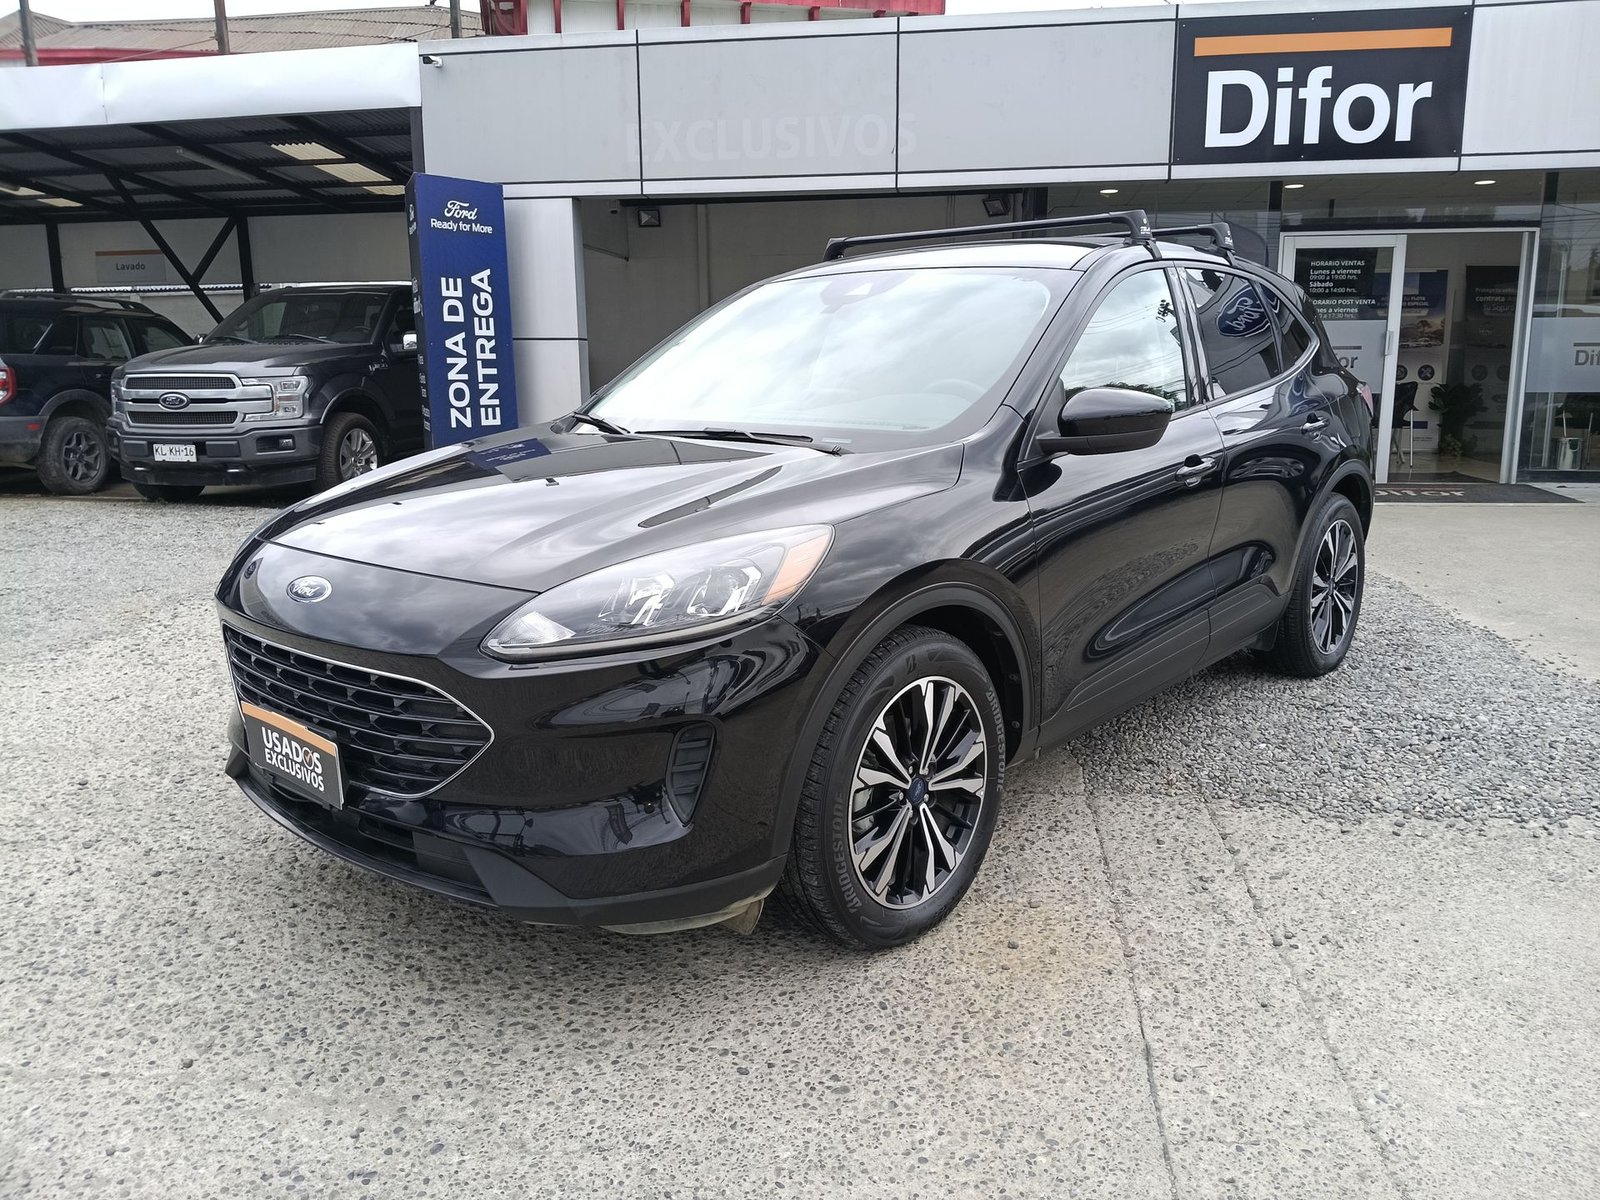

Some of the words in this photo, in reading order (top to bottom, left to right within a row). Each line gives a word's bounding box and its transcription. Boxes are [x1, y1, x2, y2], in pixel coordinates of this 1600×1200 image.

[1204, 66, 1433, 148] Difor
[625, 114, 918, 163] EXCLUSIVOS
[430, 218, 458, 232] Ready
[459, 221, 471, 231] for
[472, 223, 493, 234] More
[444, 200, 478, 220] Ford
[115, 263, 146, 271] Lavado
[441, 277, 465, 323] DE
[471, 268, 501, 427] ENTREGA
[444, 332, 472, 429] ZONA
[261, 726, 323, 774] USADOS
[264, 747, 325, 792] EXCLUSIVOS
